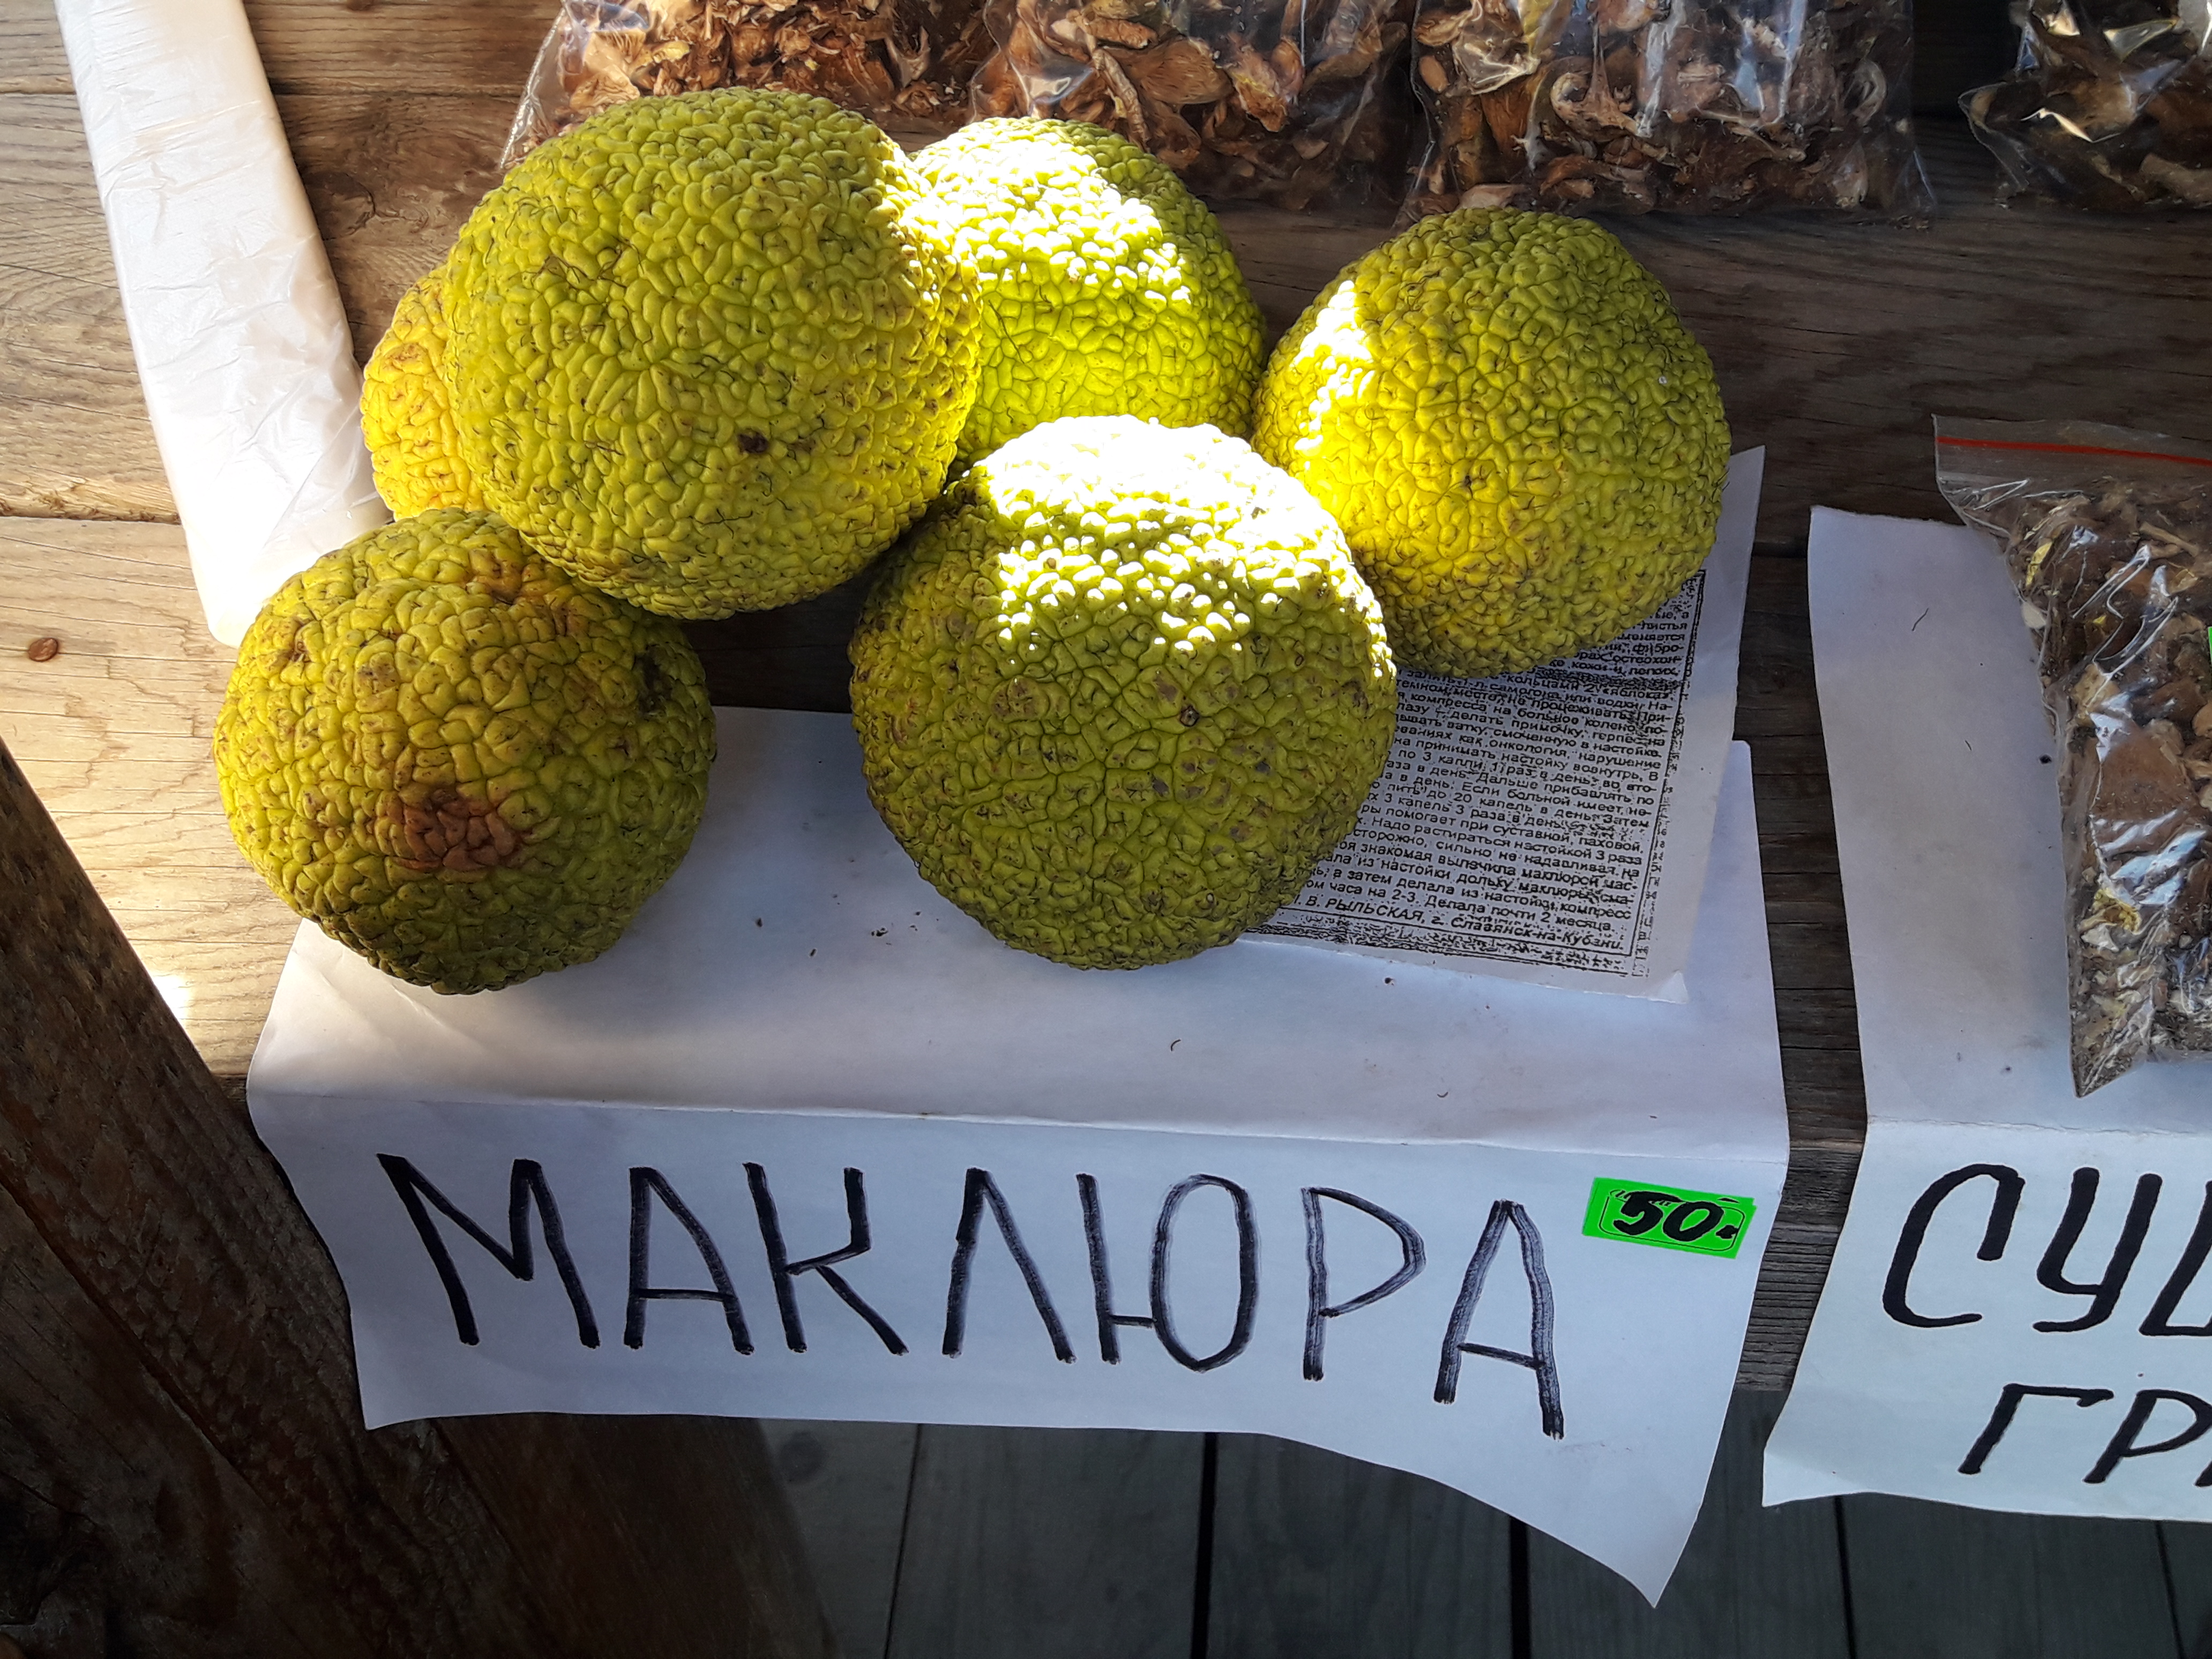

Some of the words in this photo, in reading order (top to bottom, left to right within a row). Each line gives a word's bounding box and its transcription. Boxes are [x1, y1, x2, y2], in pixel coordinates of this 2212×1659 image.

[1398, 749, 1416, 759] по
[1422, 751, 1432, 761] 3
[1386, 759, 1410, 770] аза
[1636, 796, 1654, 805] по
[1399, 774, 1408, 782] в
[1384, 793, 1392, 803] 3
[1455, 804, 1464, 814] 3
[1426, 790, 1447, 799] до
[1453, 792, 1472, 803] 20
[1540, 806, 1548, 814] в
[1371, 816, 1410, 831] Надо
[1460, 820, 1489, 832] при
[1339, 841, 1356, 851] оя
[1360, 843, 1432, 862] знакомая
[1436, 841, 1492, 857] сильно
[1329, 882, 1363, 894] часа
[1367, 888, 1386, 898] на
[1540, 911, 1551, 923] 2
[377, 1153, 1566, 1440] МАКЛЮРА
[1958, 1383, 2212, 1488] ГР
